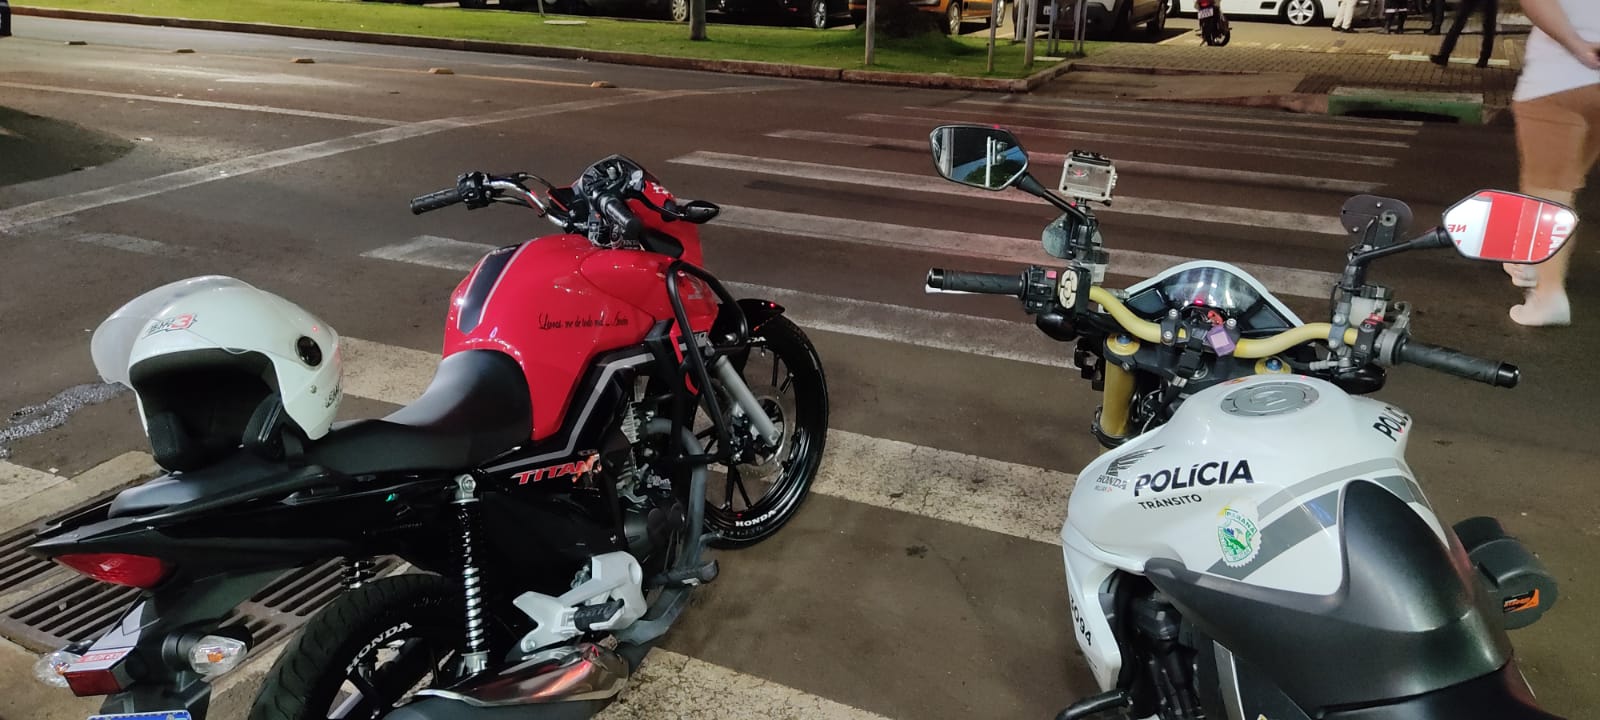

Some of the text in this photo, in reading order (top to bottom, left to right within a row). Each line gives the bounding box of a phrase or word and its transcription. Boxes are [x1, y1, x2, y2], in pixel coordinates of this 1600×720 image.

[1096, 474, 1127, 490] HONDA
[1134, 460, 1254, 497] POLÍCIA
[735, 509, 777, 527] HONDA
[346, 621, 413, 676] HONDA
